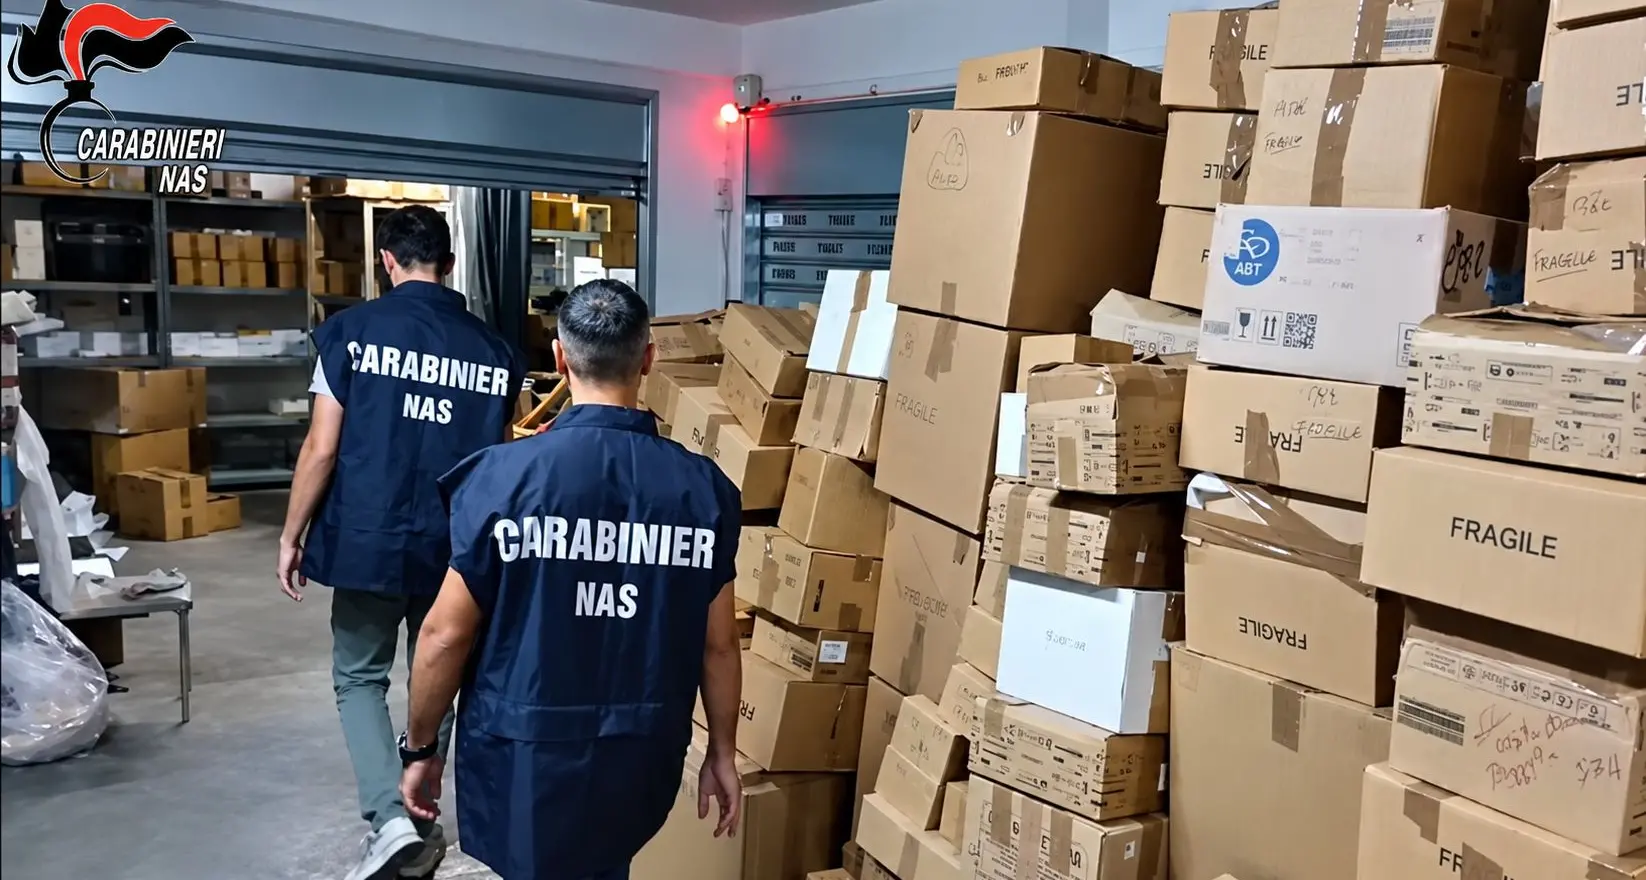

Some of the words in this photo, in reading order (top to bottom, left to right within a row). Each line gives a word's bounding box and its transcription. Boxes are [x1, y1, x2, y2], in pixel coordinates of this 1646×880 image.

[1209, 44, 1268, 60] FGILE
[1234, 262, 1263, 277] ABT
[347, 340, 510, 397] CARABINIER
[402, 392, 453, 425] NAS
[895, 392, 938, 425] FRAGILE
[1234, 425, 1303, 453] FRAE
[494, 515, 716, 570] CARABINIER
[1450, 516, 1558, 560] FRAGILE
[575, 581, 639, 619] NAS
[1238, 616, 1307, 650] FRAGILE
